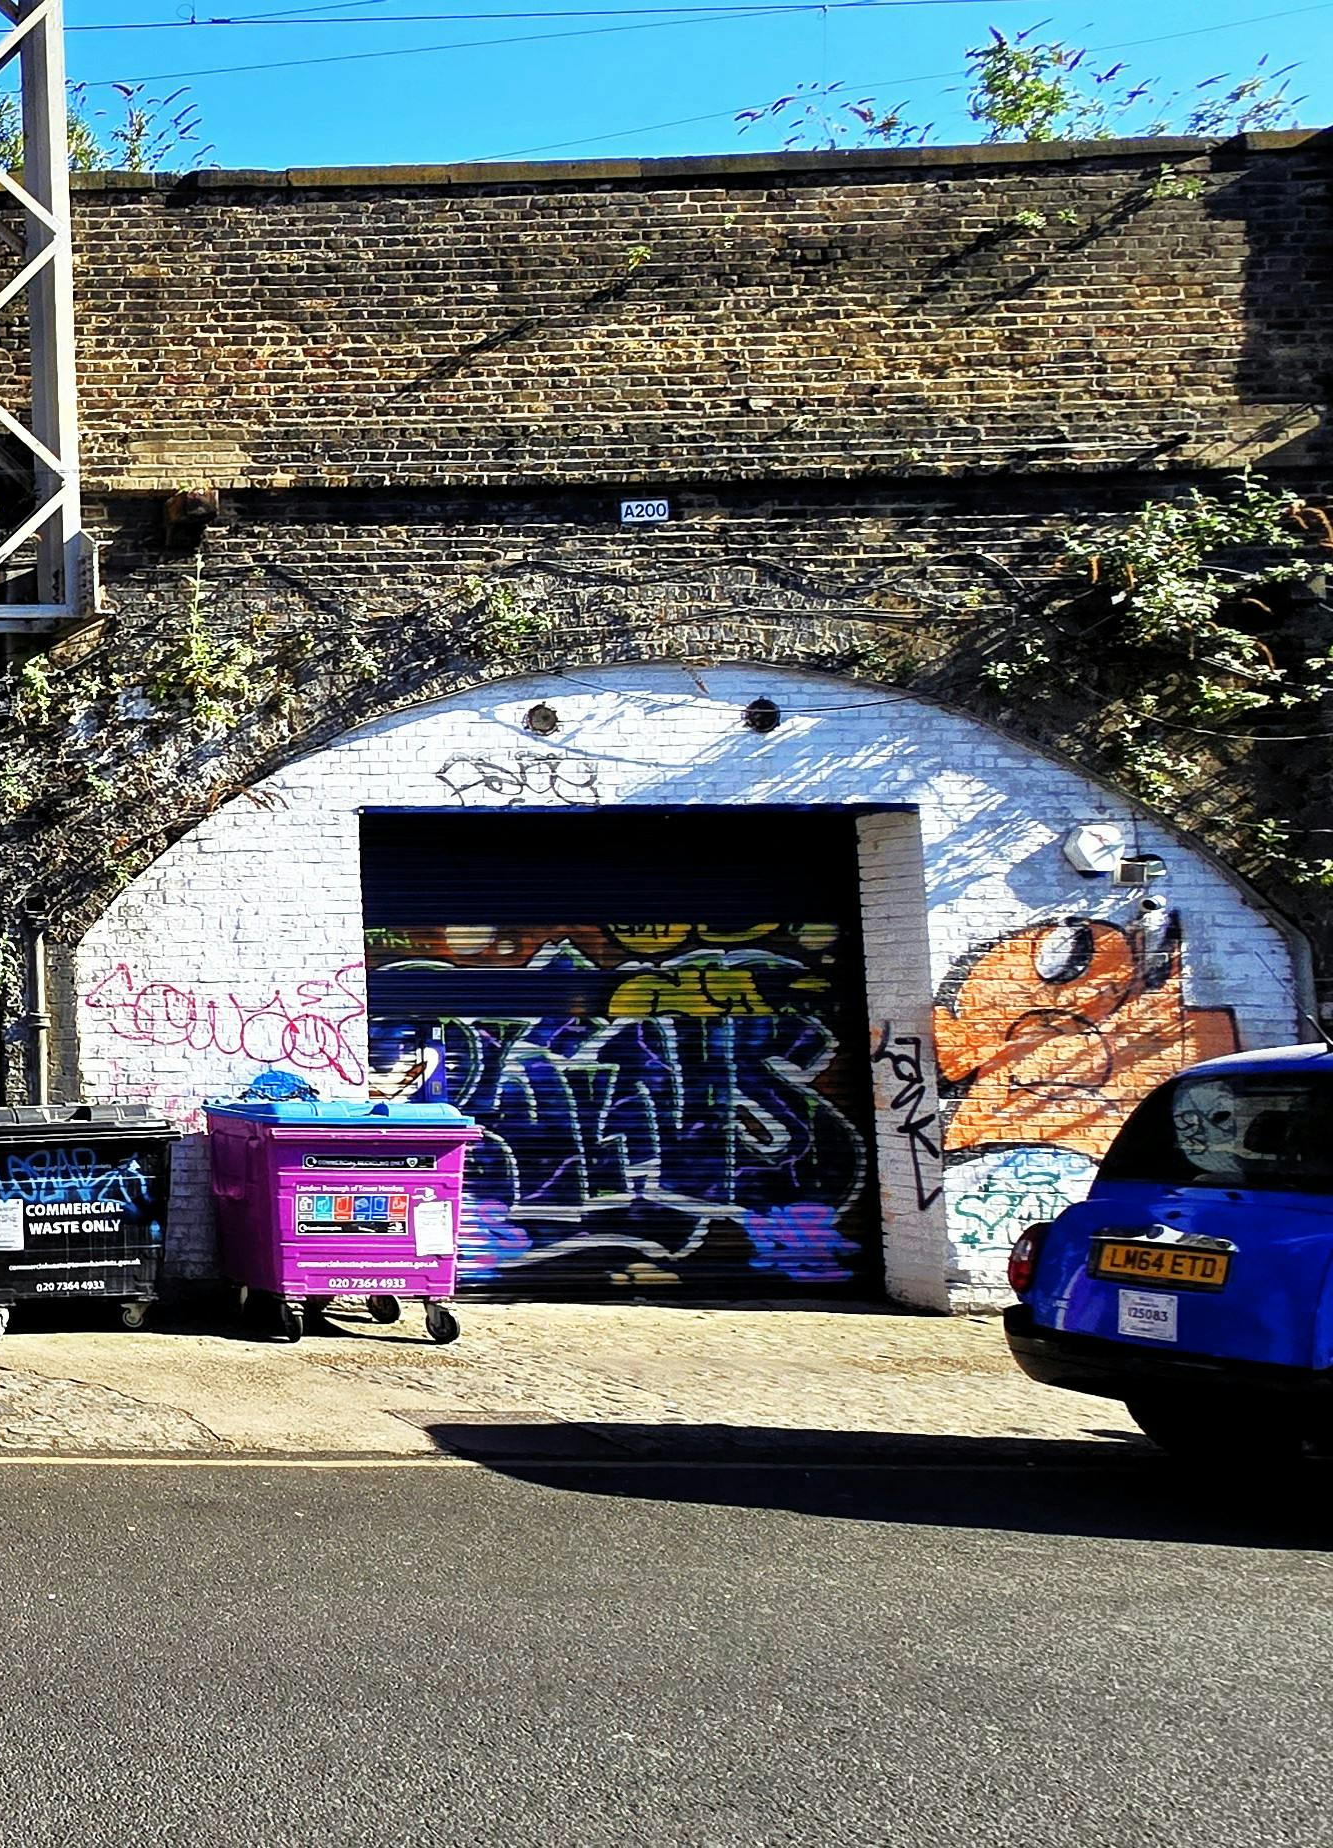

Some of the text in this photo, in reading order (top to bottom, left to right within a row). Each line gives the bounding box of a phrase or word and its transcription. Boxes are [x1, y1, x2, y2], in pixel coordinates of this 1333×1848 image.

[624, 503, 667, 518] A200
[296, 1184, 321, 1192] London
[322, 1184, 350, 1193] Borough
[25, 1201, 124, 1217] COMMERCIAL
[28, 1219, 121, 1236] WASTE ONLY
[1110, 1248, 1217, 1278] LM64 ETD
[36, 1280, 105, 1293] 020 7364 4933
[329, 1278, 406, 1289] 020 7364 4933
